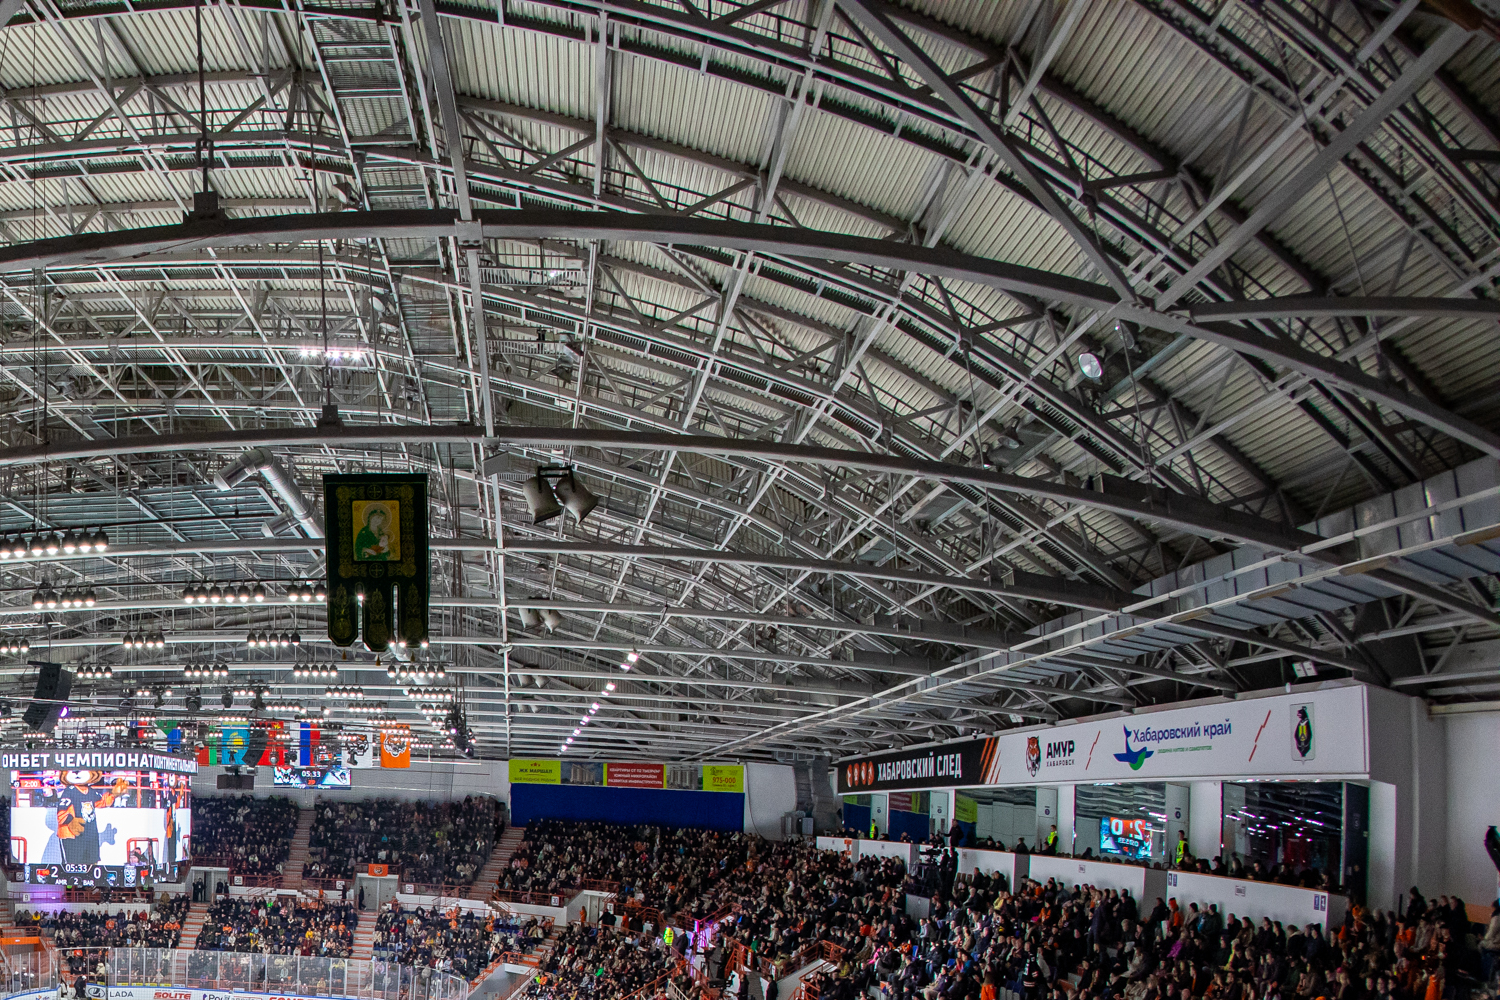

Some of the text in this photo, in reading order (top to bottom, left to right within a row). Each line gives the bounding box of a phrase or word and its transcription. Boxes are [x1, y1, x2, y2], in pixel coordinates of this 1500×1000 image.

[1133, 718, 1232, 743] Хабаровский край
[1046, 740, 1075, 759] АМУР
[54, 753, 154, 768] ЧЕМПИОНАТ
[877, 751, 962, 781] ХАБАРОВСКИЙ СЛЕД
[1046, 758, 1075, 767] ХАБАРОВСК
[50, 866, 58, 877] 2
[65, 863, 88, 873] 05:33
[93, 867, 101, 879] 0
[55, 878, 67, 886] AMR
[83, 879, 94, 887] BAR
[153, 991, 192, 1000] SOLITE
